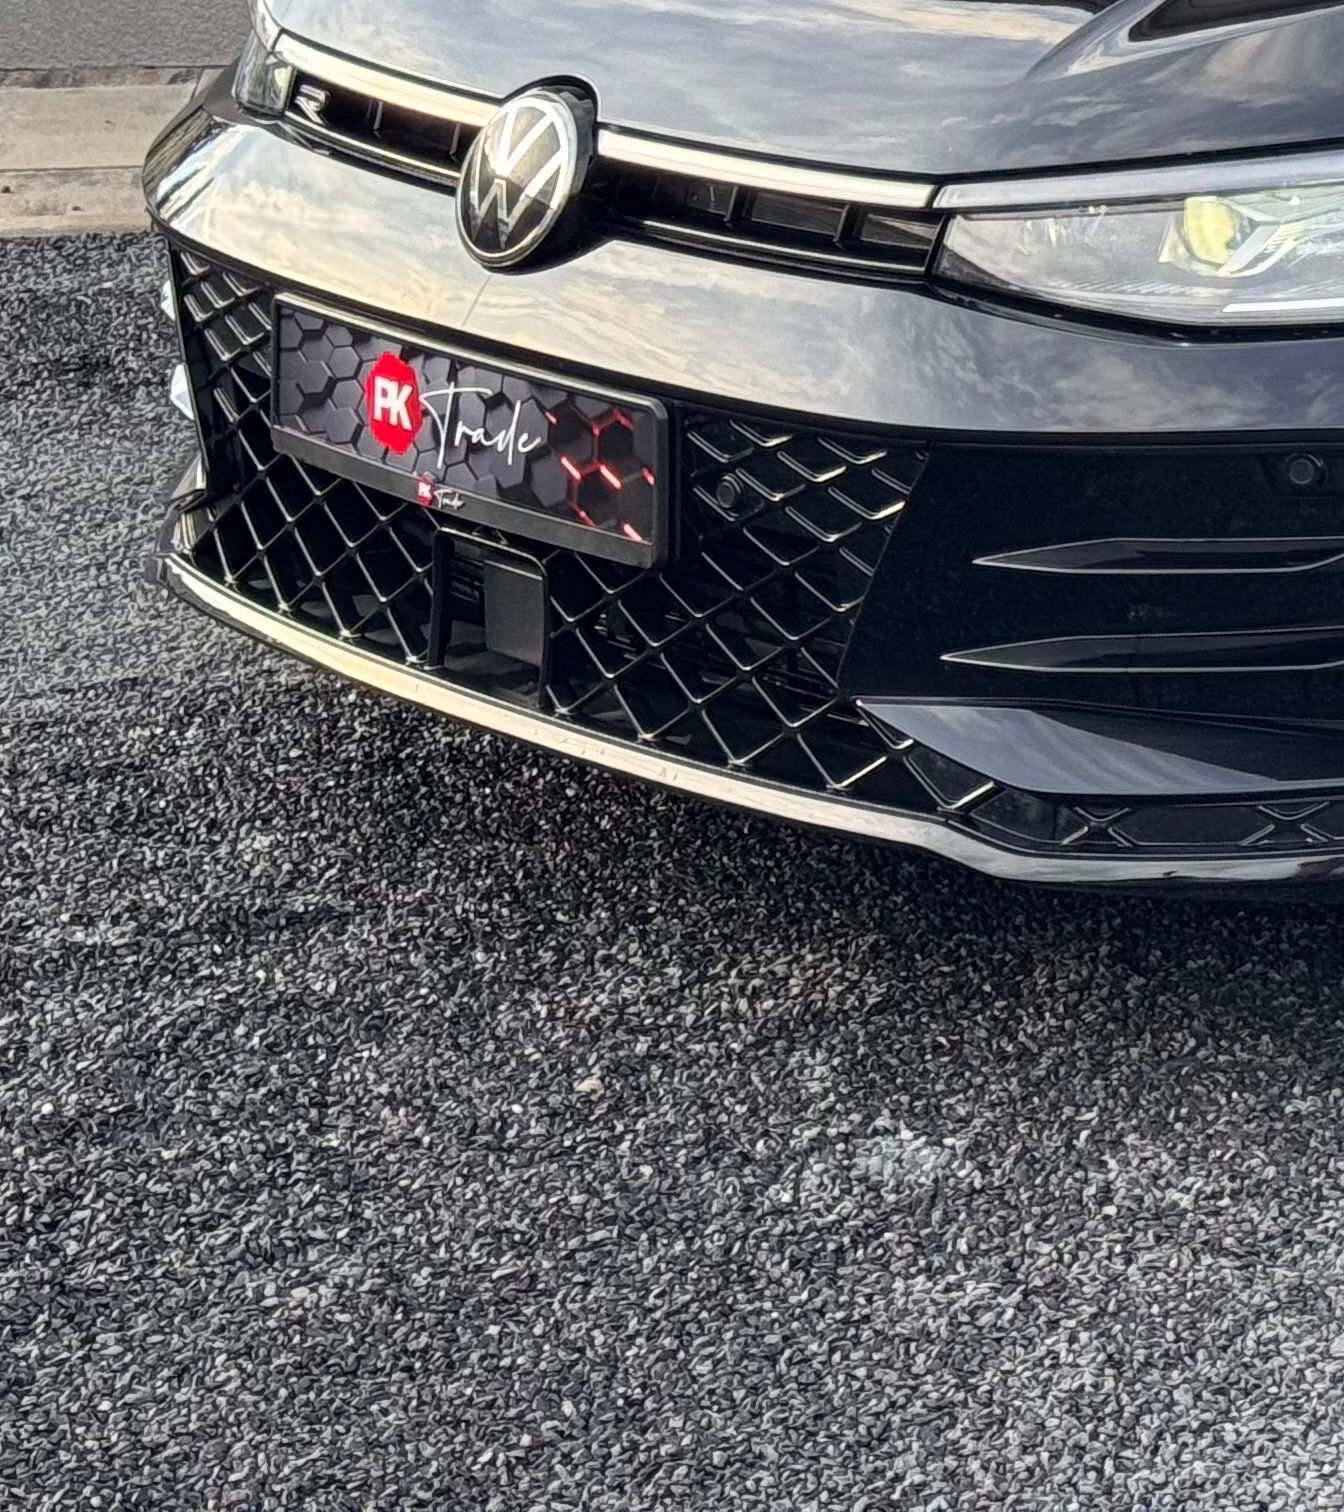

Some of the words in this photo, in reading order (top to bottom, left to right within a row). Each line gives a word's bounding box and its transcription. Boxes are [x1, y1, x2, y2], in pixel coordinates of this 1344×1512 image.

[294, 84, 330, 127] R
[373, 375, 414, 432] PK
[419, 381, 543, 470] Trade
